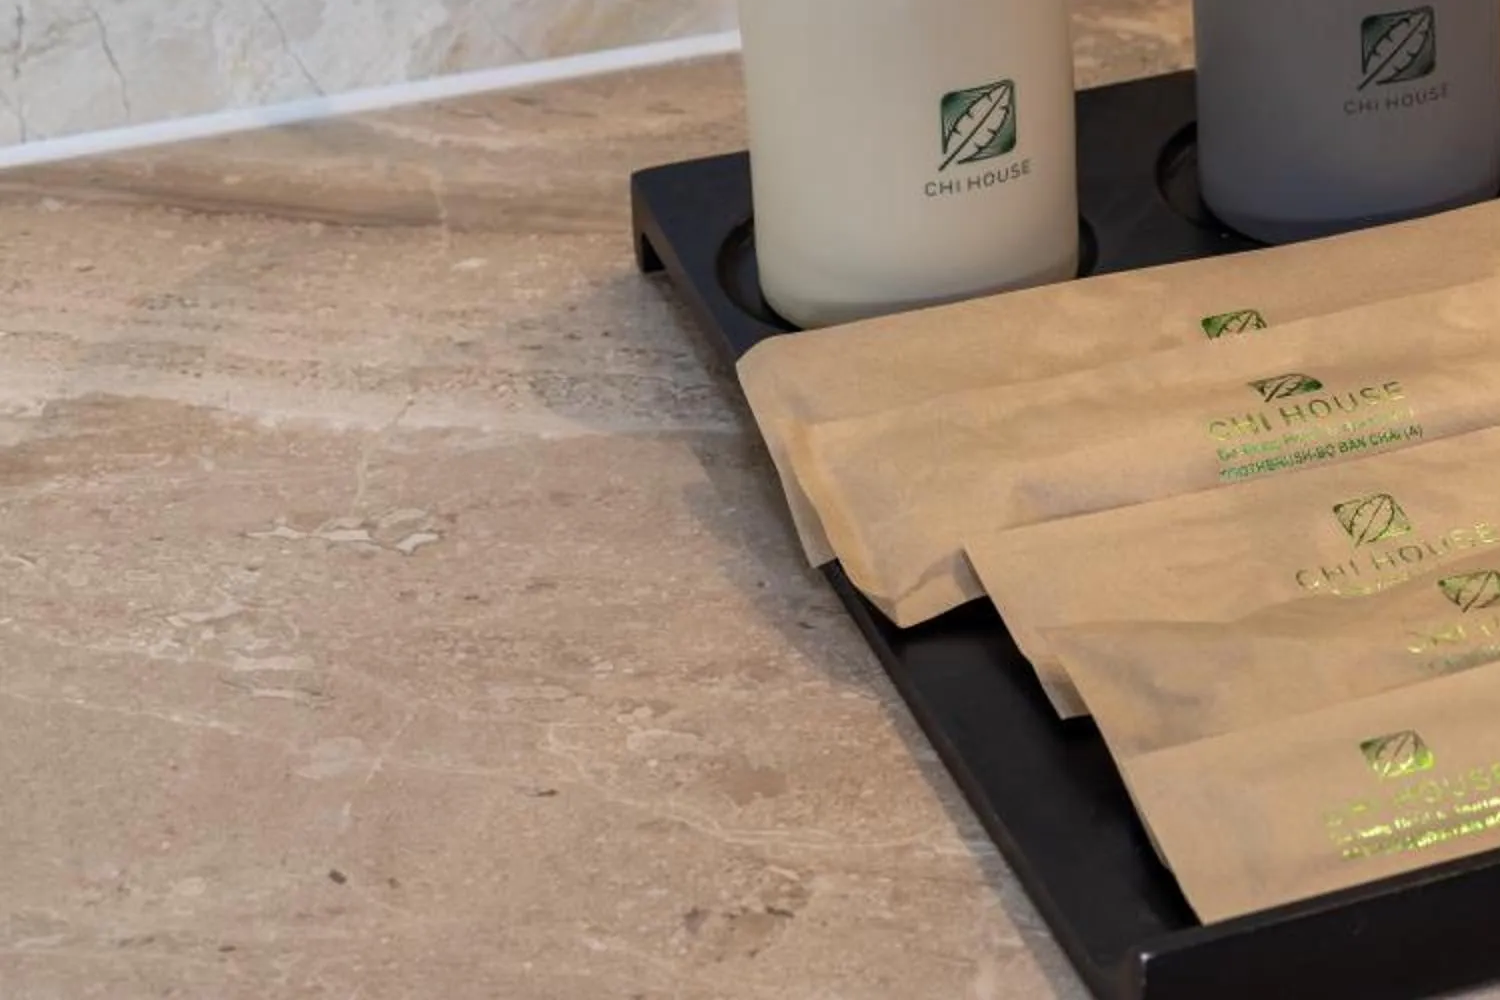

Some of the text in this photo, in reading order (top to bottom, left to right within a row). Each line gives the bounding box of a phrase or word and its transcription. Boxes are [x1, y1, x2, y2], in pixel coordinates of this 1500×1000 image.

[1343, 82, 1450, 116] CHI HOUSE
[924, 158, 1033, 197] CHI HOUSE
[1208, 412, 1272, 441] CHI
[1279, 381, 1405, 426] HOUSE
[1295, 559, 1360, 589] CHI
[1371, 523, 1500, 571] HOUSE
